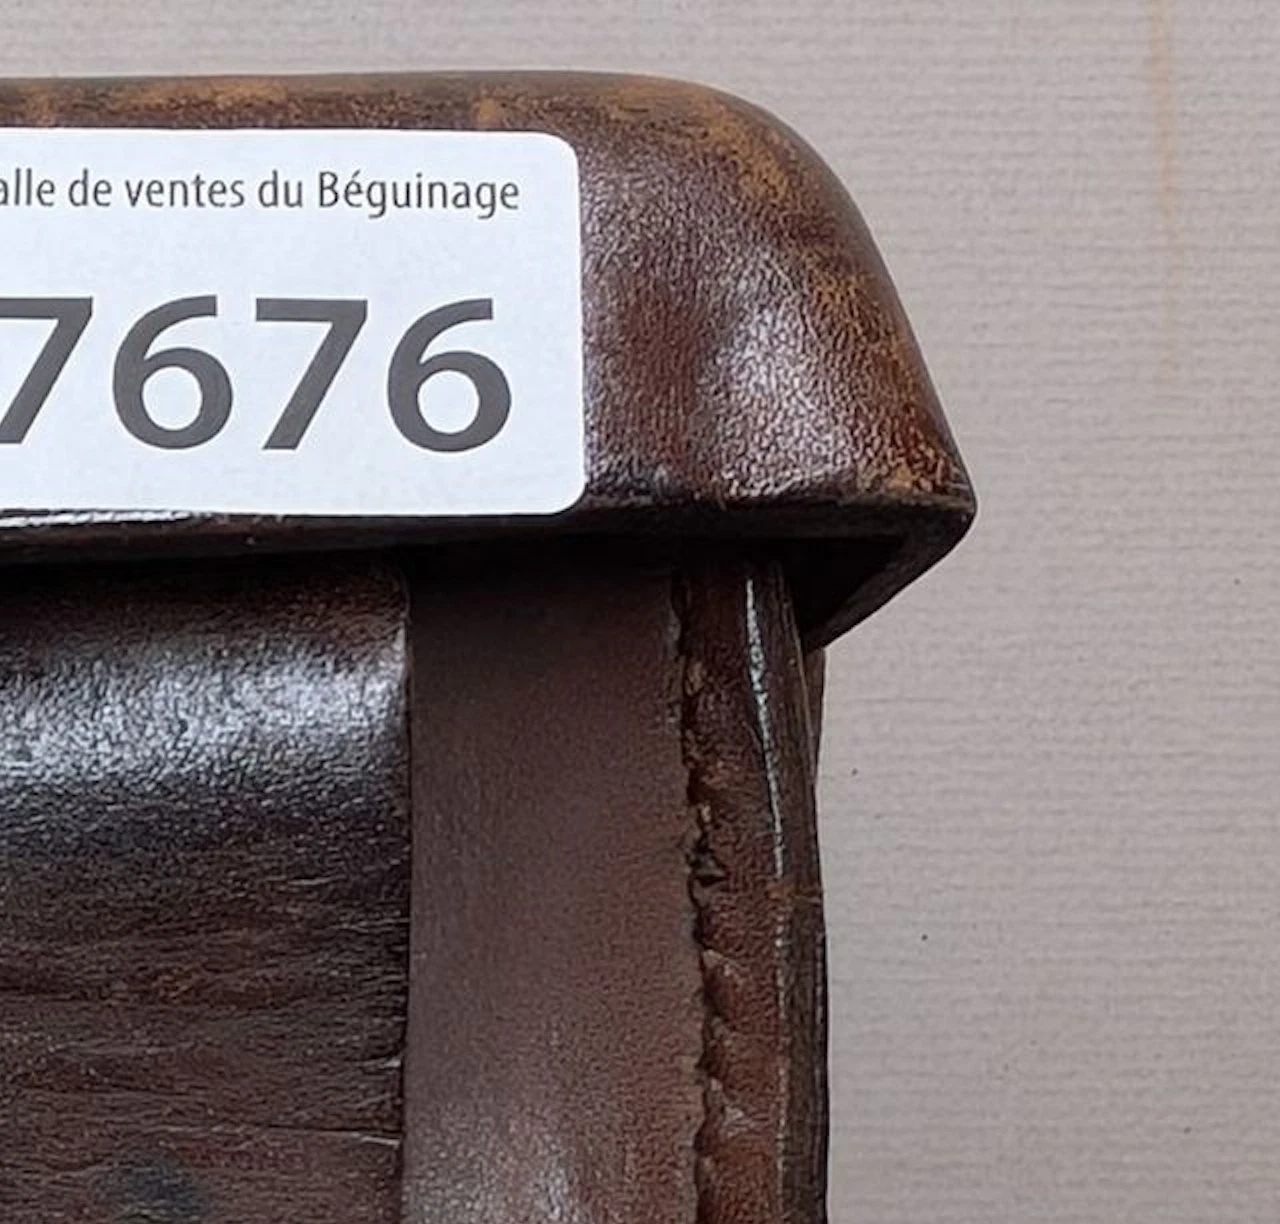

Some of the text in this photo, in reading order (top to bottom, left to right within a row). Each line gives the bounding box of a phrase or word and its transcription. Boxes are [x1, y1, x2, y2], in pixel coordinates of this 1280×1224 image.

[68, 168, 112, 207] de
[125, 175, 244, 207] ventes
[258, 170, 302, 208] du
[319, 170, 518, 219] Béguinage
